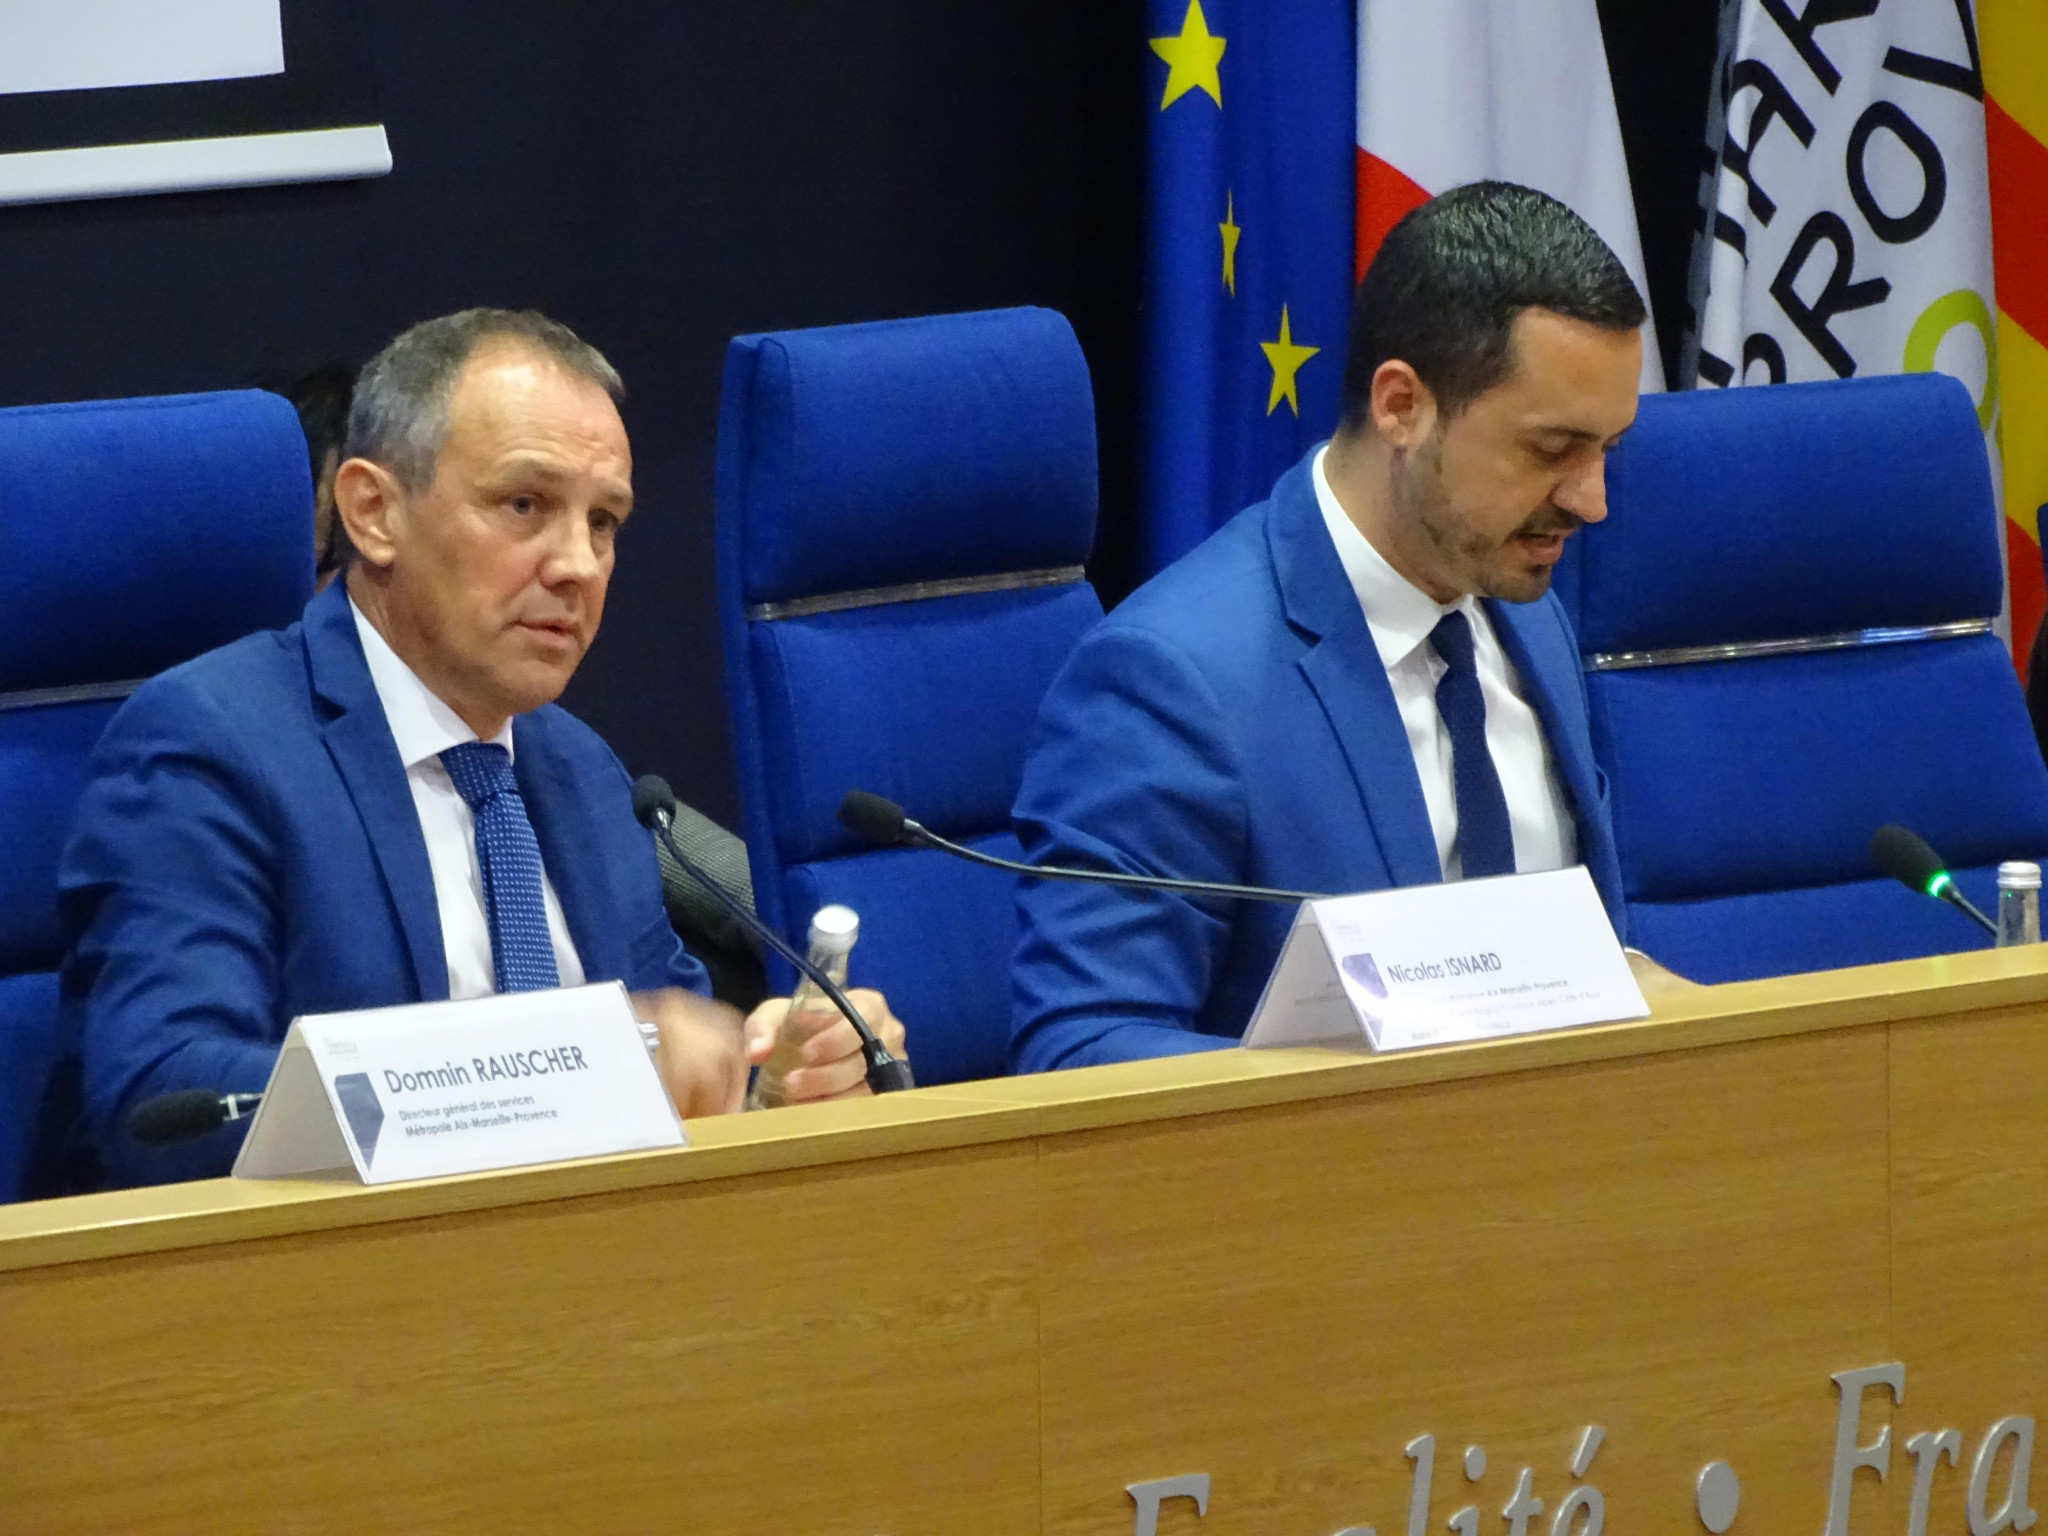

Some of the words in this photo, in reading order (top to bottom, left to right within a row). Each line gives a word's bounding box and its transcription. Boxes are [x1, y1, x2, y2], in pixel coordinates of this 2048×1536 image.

[1387, 963, 1445, 985] Nicolas
[1445, 952, 1502, 977] ISNARD
[384, 1060, 472, 1094] Domnin
[472, 1045, 589, 1082] RAUSCHER
[480, 1099, 496, 1111] des
[498, 1095, 536, 1108] services
[405, 1122, 452, 1138] Métropole
